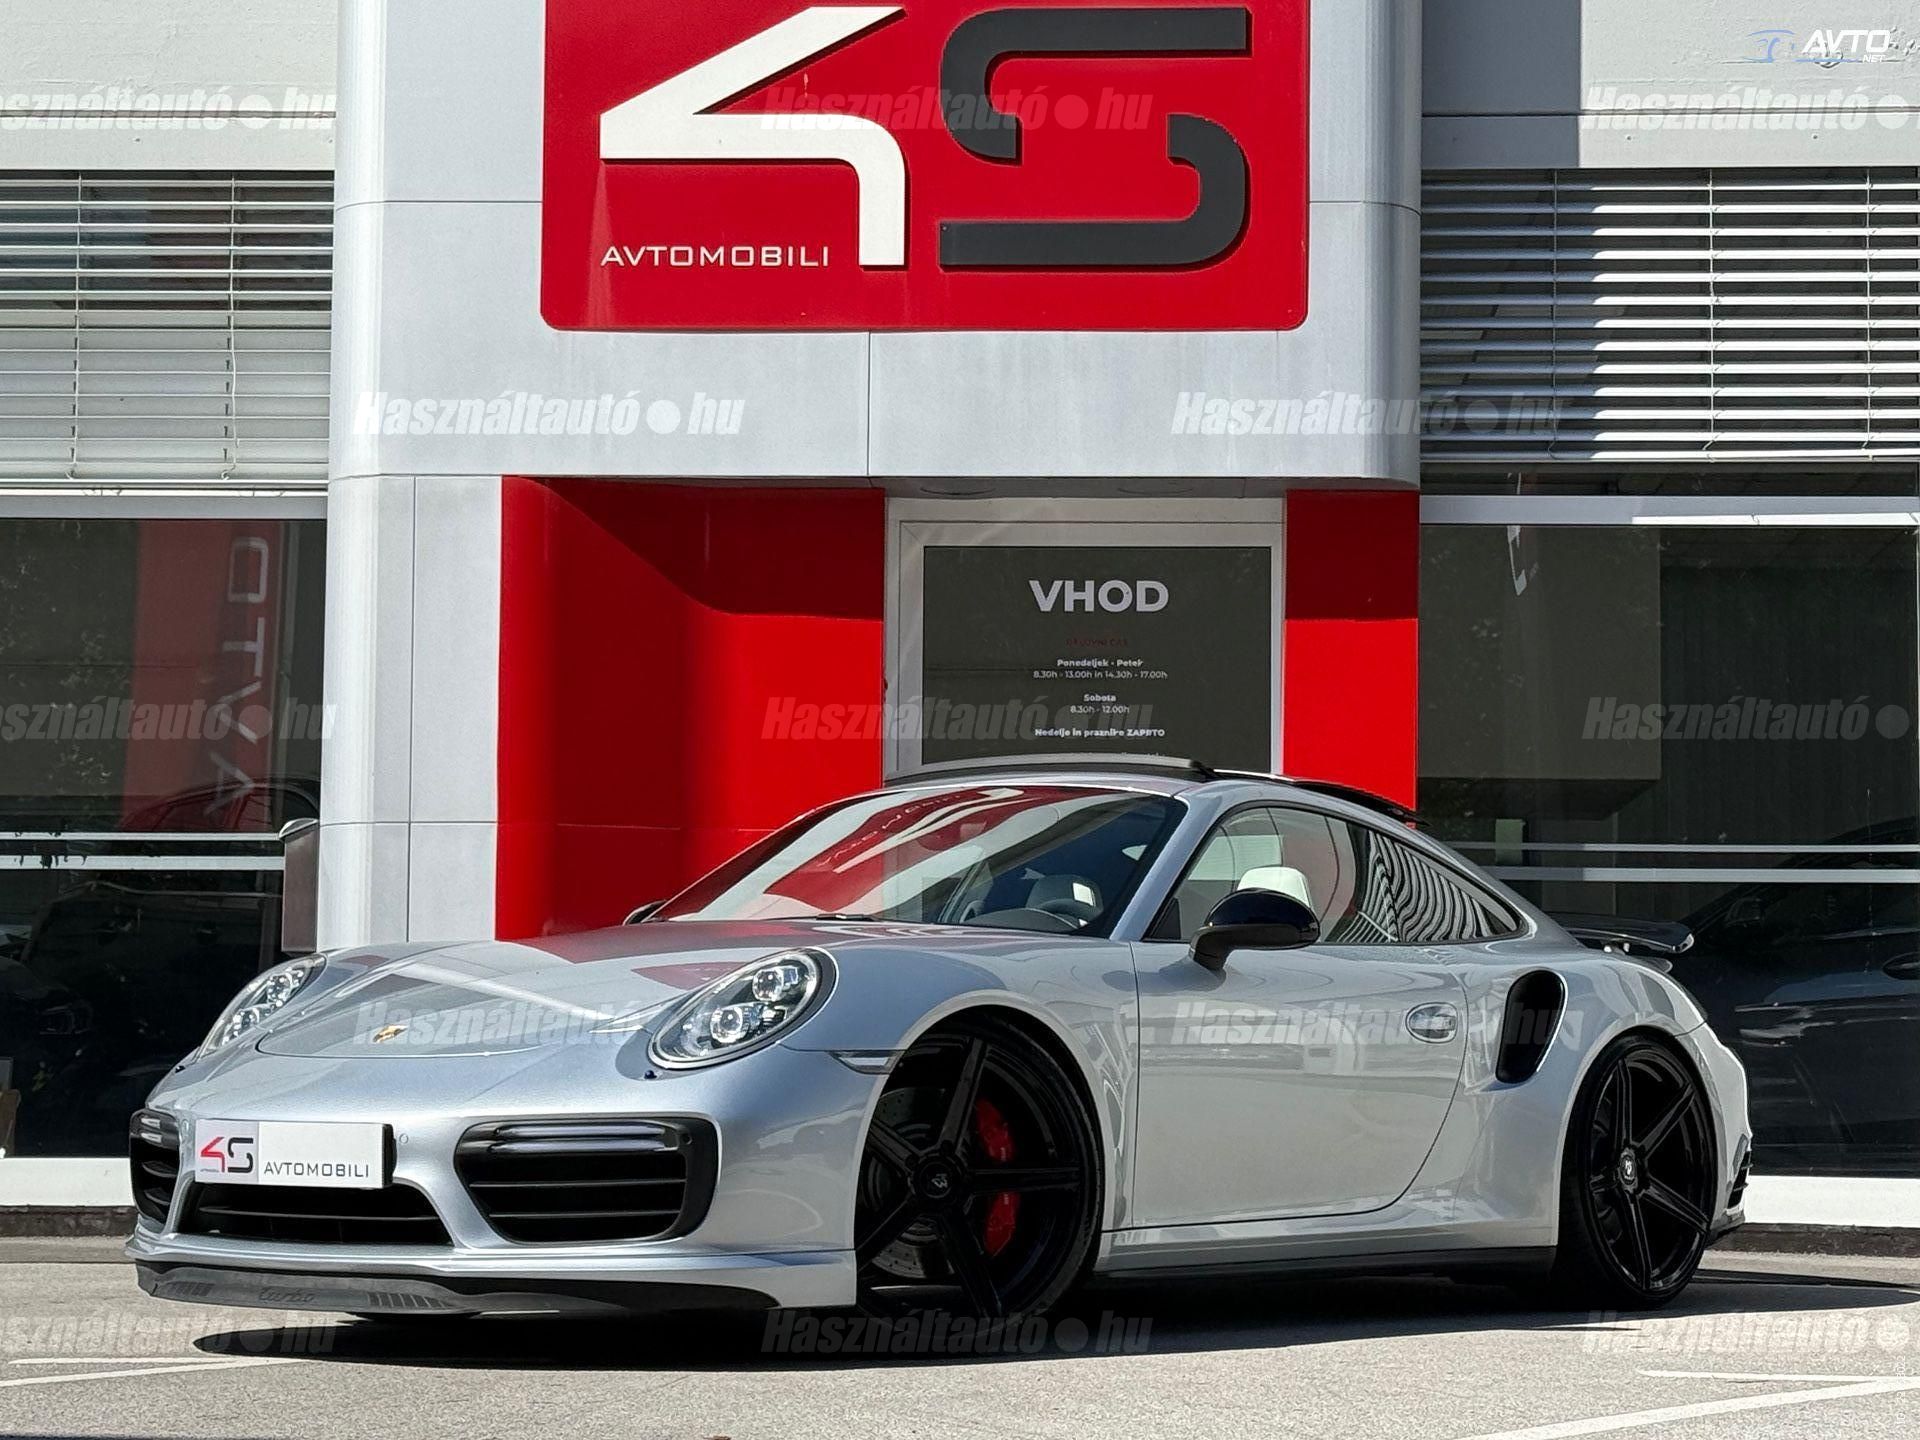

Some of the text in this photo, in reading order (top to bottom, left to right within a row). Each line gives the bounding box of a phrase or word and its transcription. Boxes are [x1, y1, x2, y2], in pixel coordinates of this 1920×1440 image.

[600, 244, 831, 267] AVTOMOBILI
[1028, 579, 1169, 612] VHOD
[1056, 658, 1110, 669] Ponedeljek
[1033, 670, 1059, 679] 8.30h
[1065, 670, 1093, 679] 13.00h
[1139, 670, 1169, 679] 17.00h
[1083, 693, 1117, 702] Sobota
[1070, 705, 1096, 714] 8.30h
[1101, 705, 1130, 714] 12.00h
[200, 1136, 254, 1174] 4S
[263, 1161, 370, 1178] AVTOMOBILI
